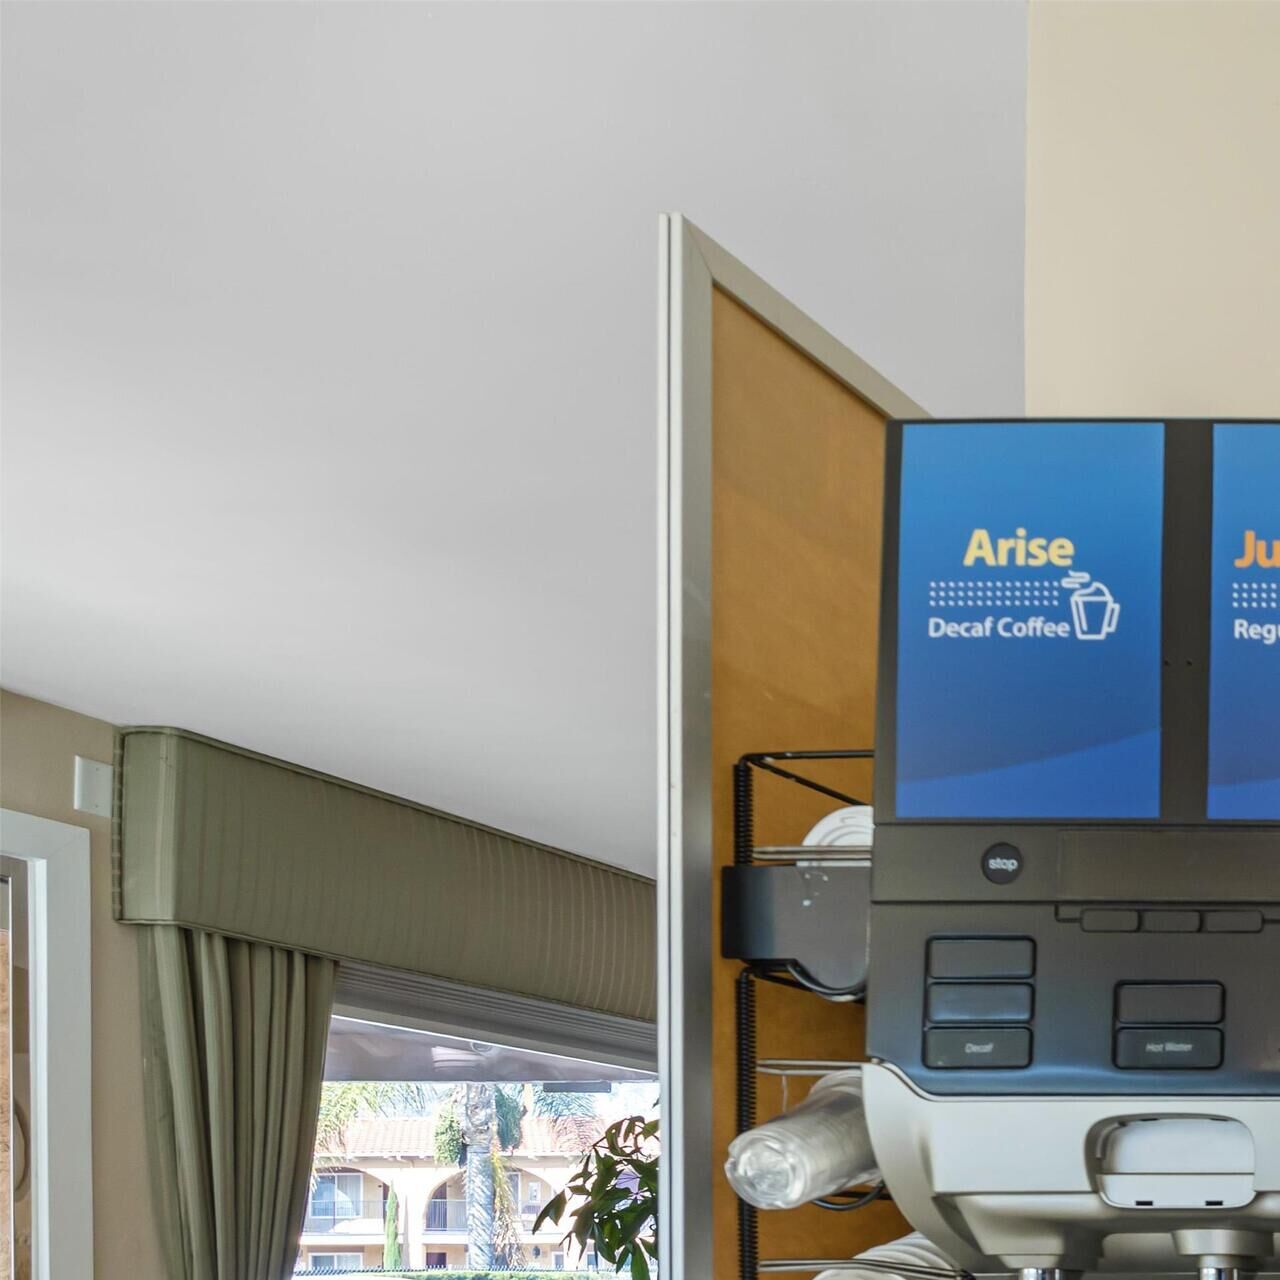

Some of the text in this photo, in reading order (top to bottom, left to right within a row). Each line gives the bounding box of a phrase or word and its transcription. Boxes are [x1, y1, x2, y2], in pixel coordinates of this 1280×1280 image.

[962, 527, 1076, 567] Arise
[928, 616, 1071, 638] Decaf Coffee
[988, 856, 1019, 872] stop
[965, 1043, 994, 1054] Decaf
